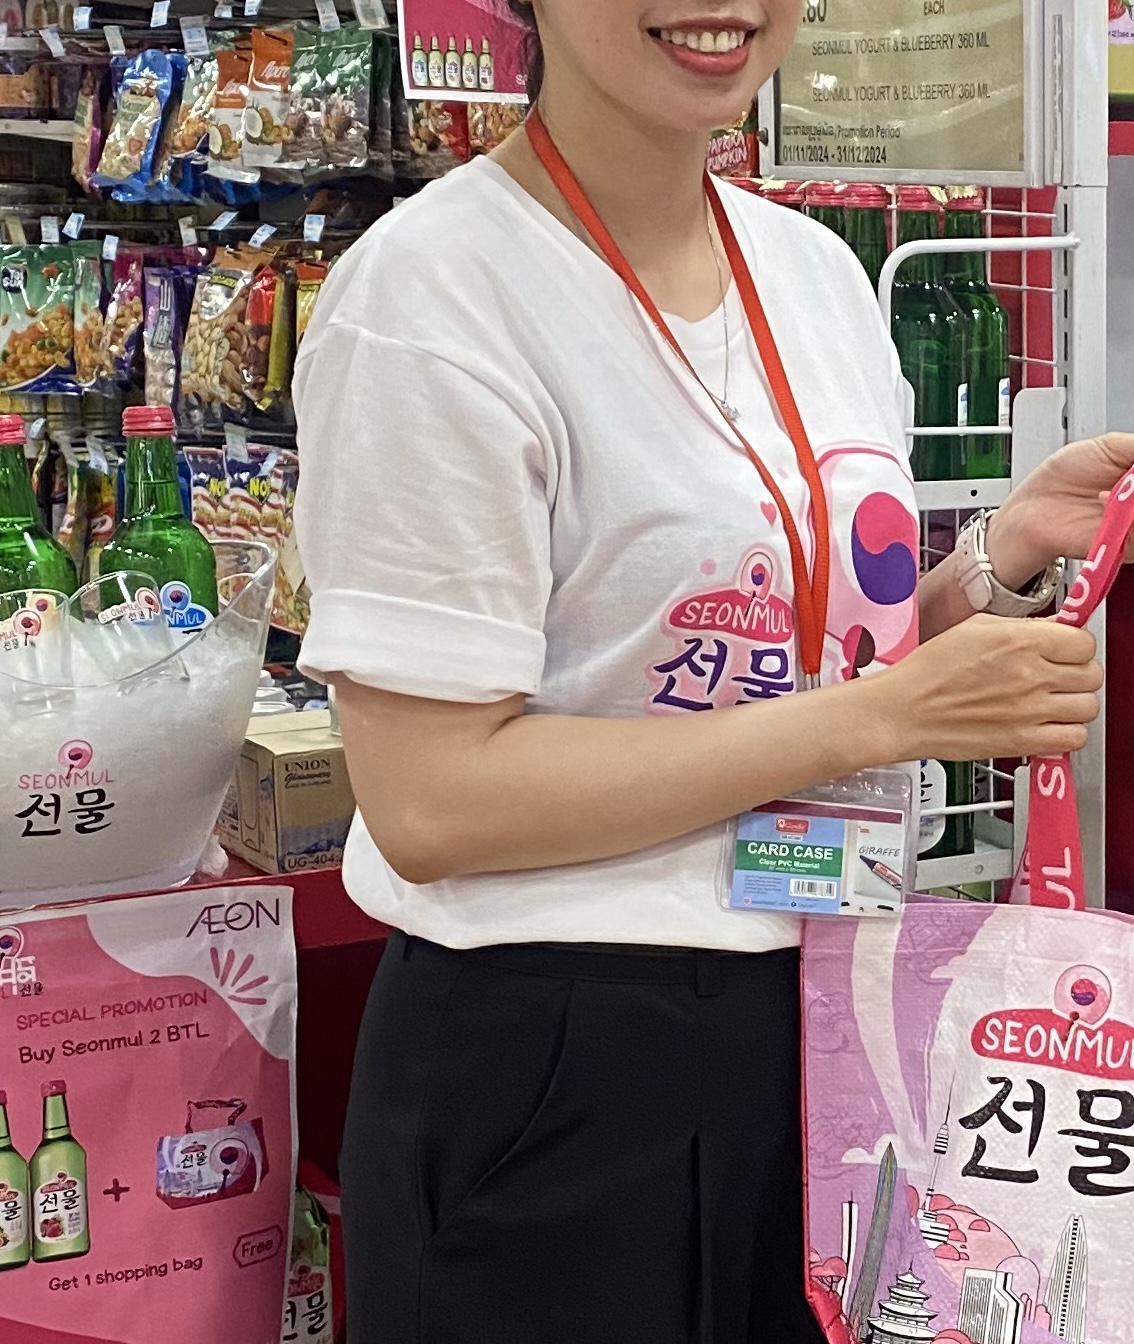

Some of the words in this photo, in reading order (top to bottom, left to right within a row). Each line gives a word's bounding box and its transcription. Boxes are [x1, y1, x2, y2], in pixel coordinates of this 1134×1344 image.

[923, 0, 945, 17] EACH
[957, 33, 975, 49] 360
[958, 83, 976, 99] 360
[782, 146, 829, 163] 01/11/2024
[836, 145, 887, 163] 31/12/2024
[680, 600, 790, 635] SEONMUL
[284, 758, 331, 773] UNION
[18, 767, 115, 790] SEONMUL
[747, 841, 790, 856] CARD
[793, 845, 834, 861] CASE
[858, 846, 902, 857] GIRAFFE
[777, 859, 793, 867] PVC
[16, 1006, 95, 1031] SPECIAL
[100, 989, 208, 1019] PROMOTION
[18, 1045, 56, 1065] Buy
[61, 1030, 143, 1057] Seonmul
[149, 1030, 161, 1045] 2
[166, 1022, 210, 1043] BTL
[241, 1237, 274, 1258] Free
[48, 1276, 79, 1292] Get
[84, 1274, 92, 1286] 1
[96, 1263, 169, 1286] shopping
[172, 1256, 203, 1272] bag
